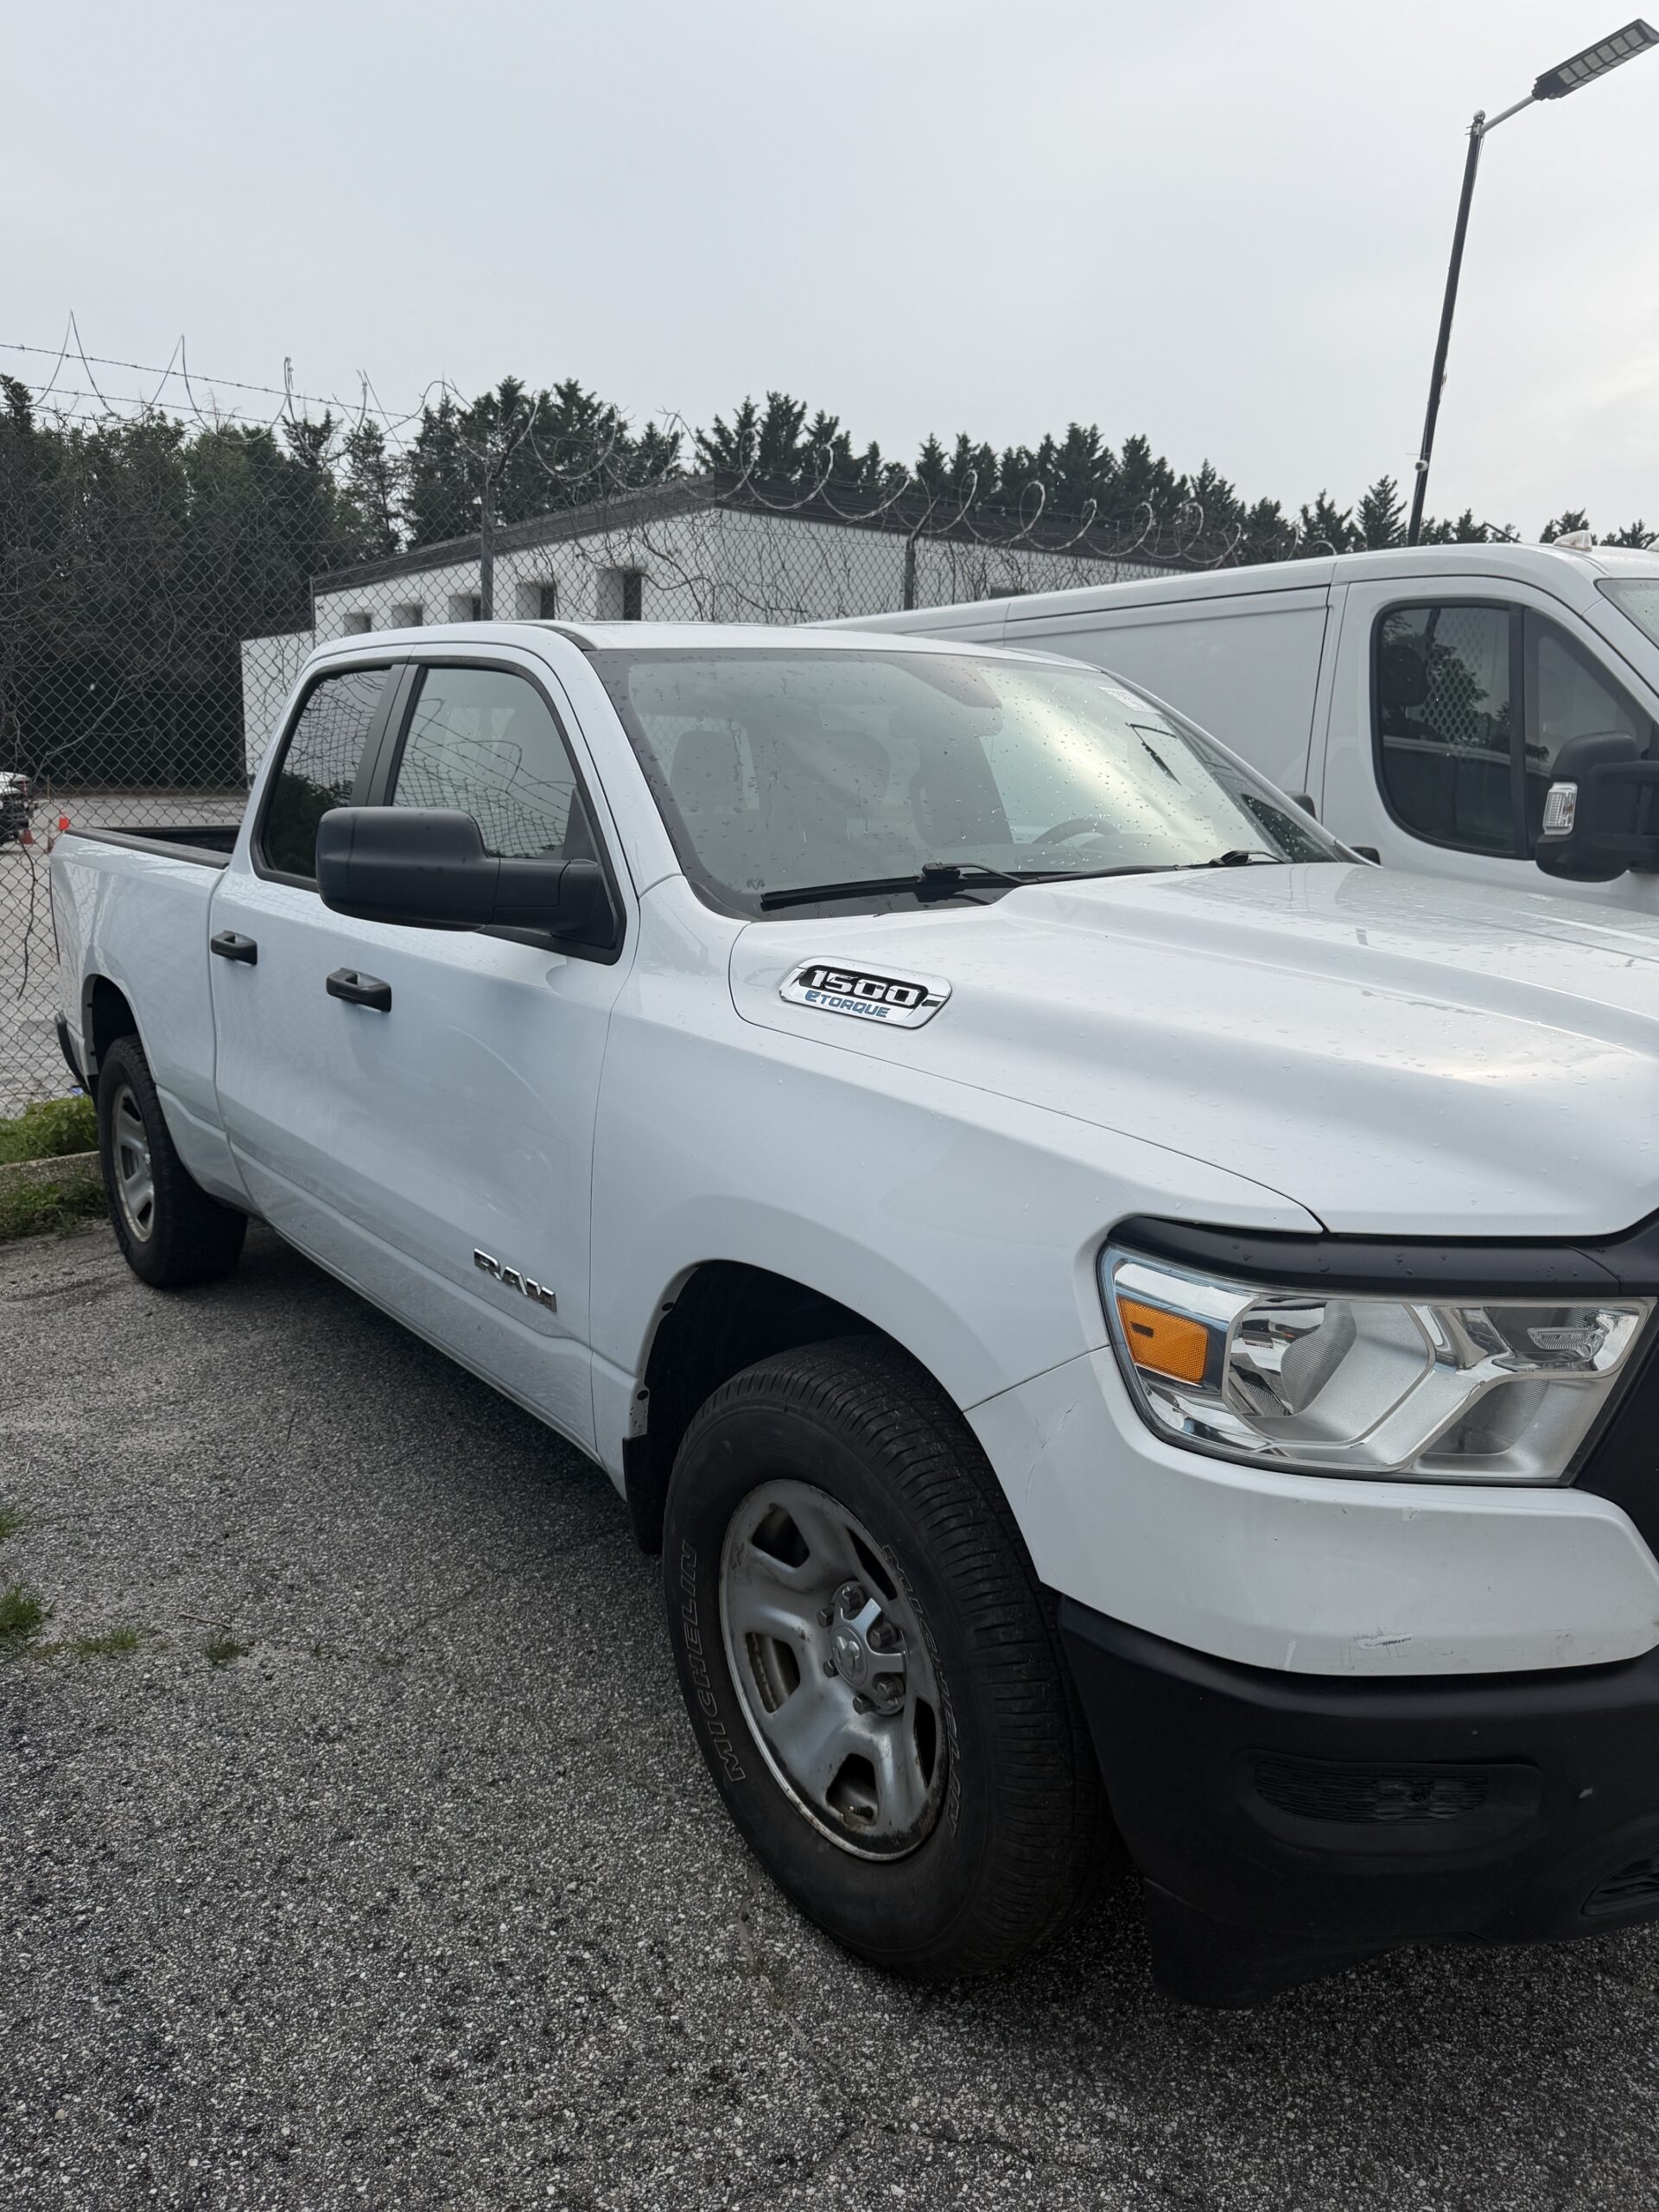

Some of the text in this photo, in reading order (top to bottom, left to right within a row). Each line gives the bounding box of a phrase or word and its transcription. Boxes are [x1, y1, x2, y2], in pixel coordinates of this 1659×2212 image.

[804, 989, 892, 1019] eTORQUE
[810, 969, 921, 1007] 1500
[474, 1248, 557, 1313] RAM
[680, 1541, 747, 1783] MICHELIN
